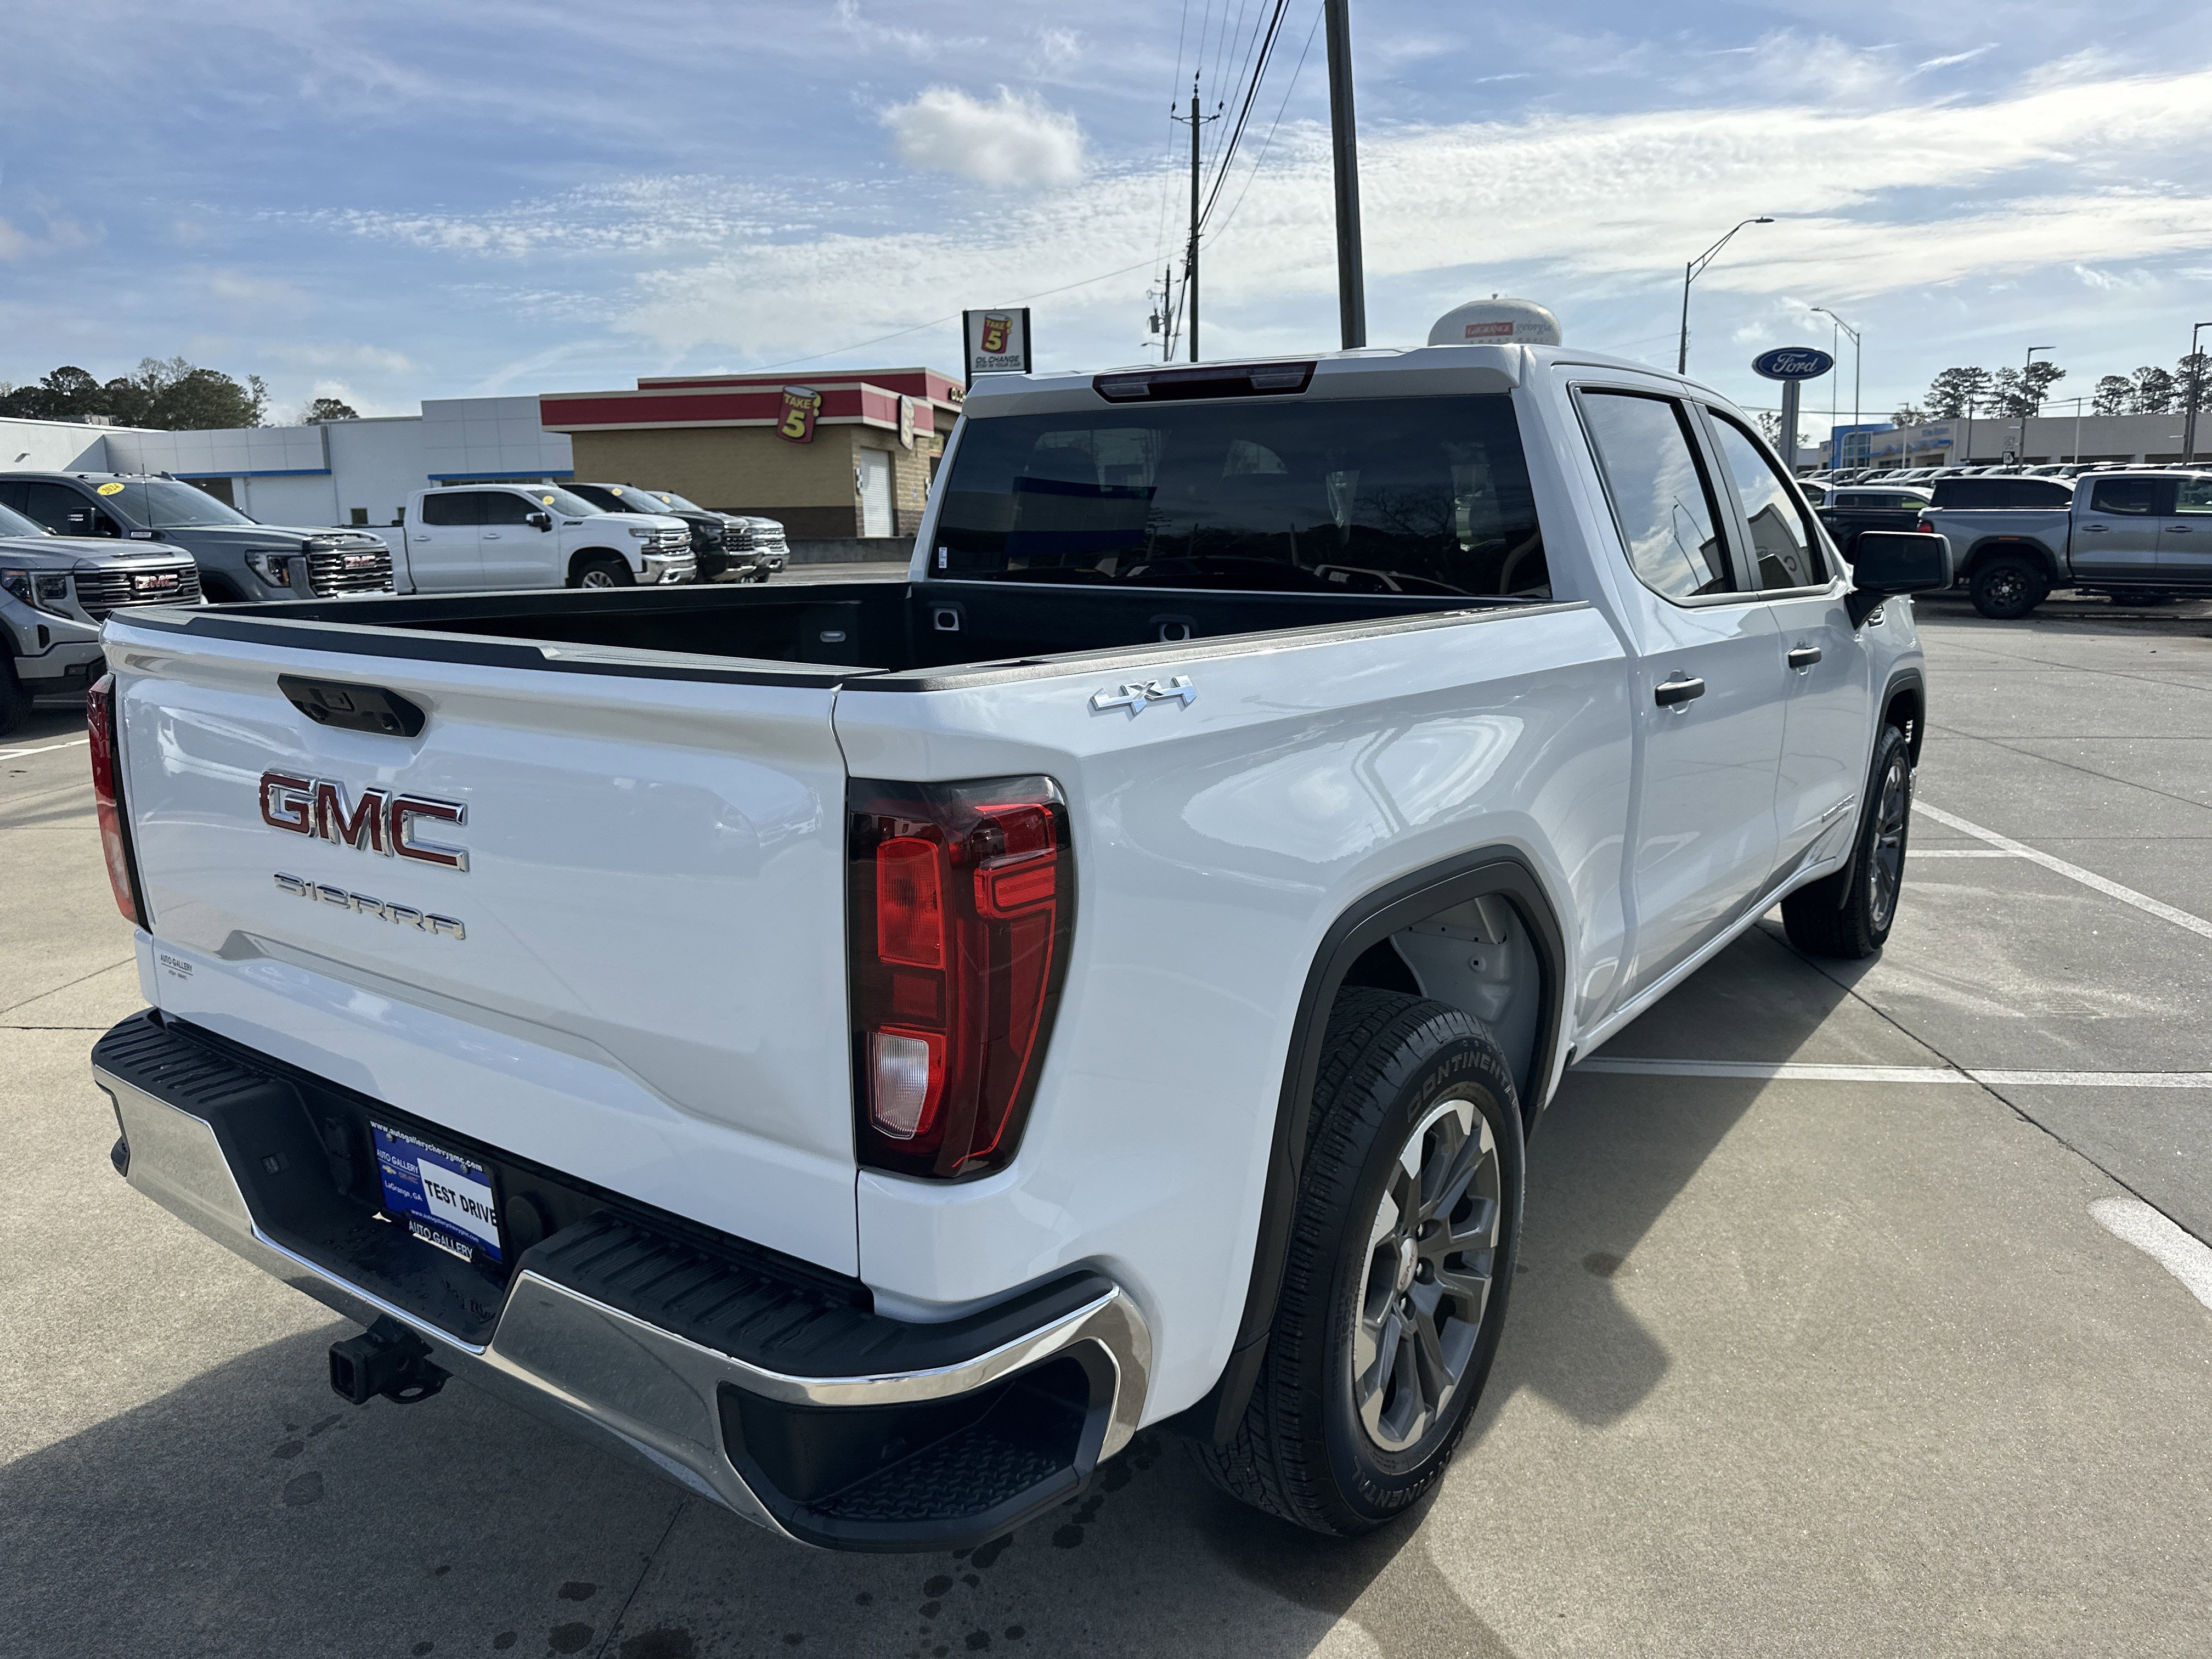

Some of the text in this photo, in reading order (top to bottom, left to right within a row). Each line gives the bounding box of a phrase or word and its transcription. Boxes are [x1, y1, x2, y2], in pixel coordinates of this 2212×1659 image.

[986, 319, 1006, 329] TAKE
[985, 331, 1002, 351] 5
[988, 355, 1020, 363] CHANGE
[1771, 353, 1818, 373] Ford
[783, 392, 812, 409] TAKE
[782, 409, 805, 438] 5
[101, 483, 120, 494] 2024
[343, 555, 376, 567] GMC
[134, 574, 178, 589] GMC
[259, 768, 471, 873] GMC
[274, 871, 466, 940] SIERRA
[376, 1148, 419, 1174] AUTO GALLERY
[424, 1179, 498, 1227] TEST DRIVE
[409, 1219, 473, 1259] AUTO GALLERY
